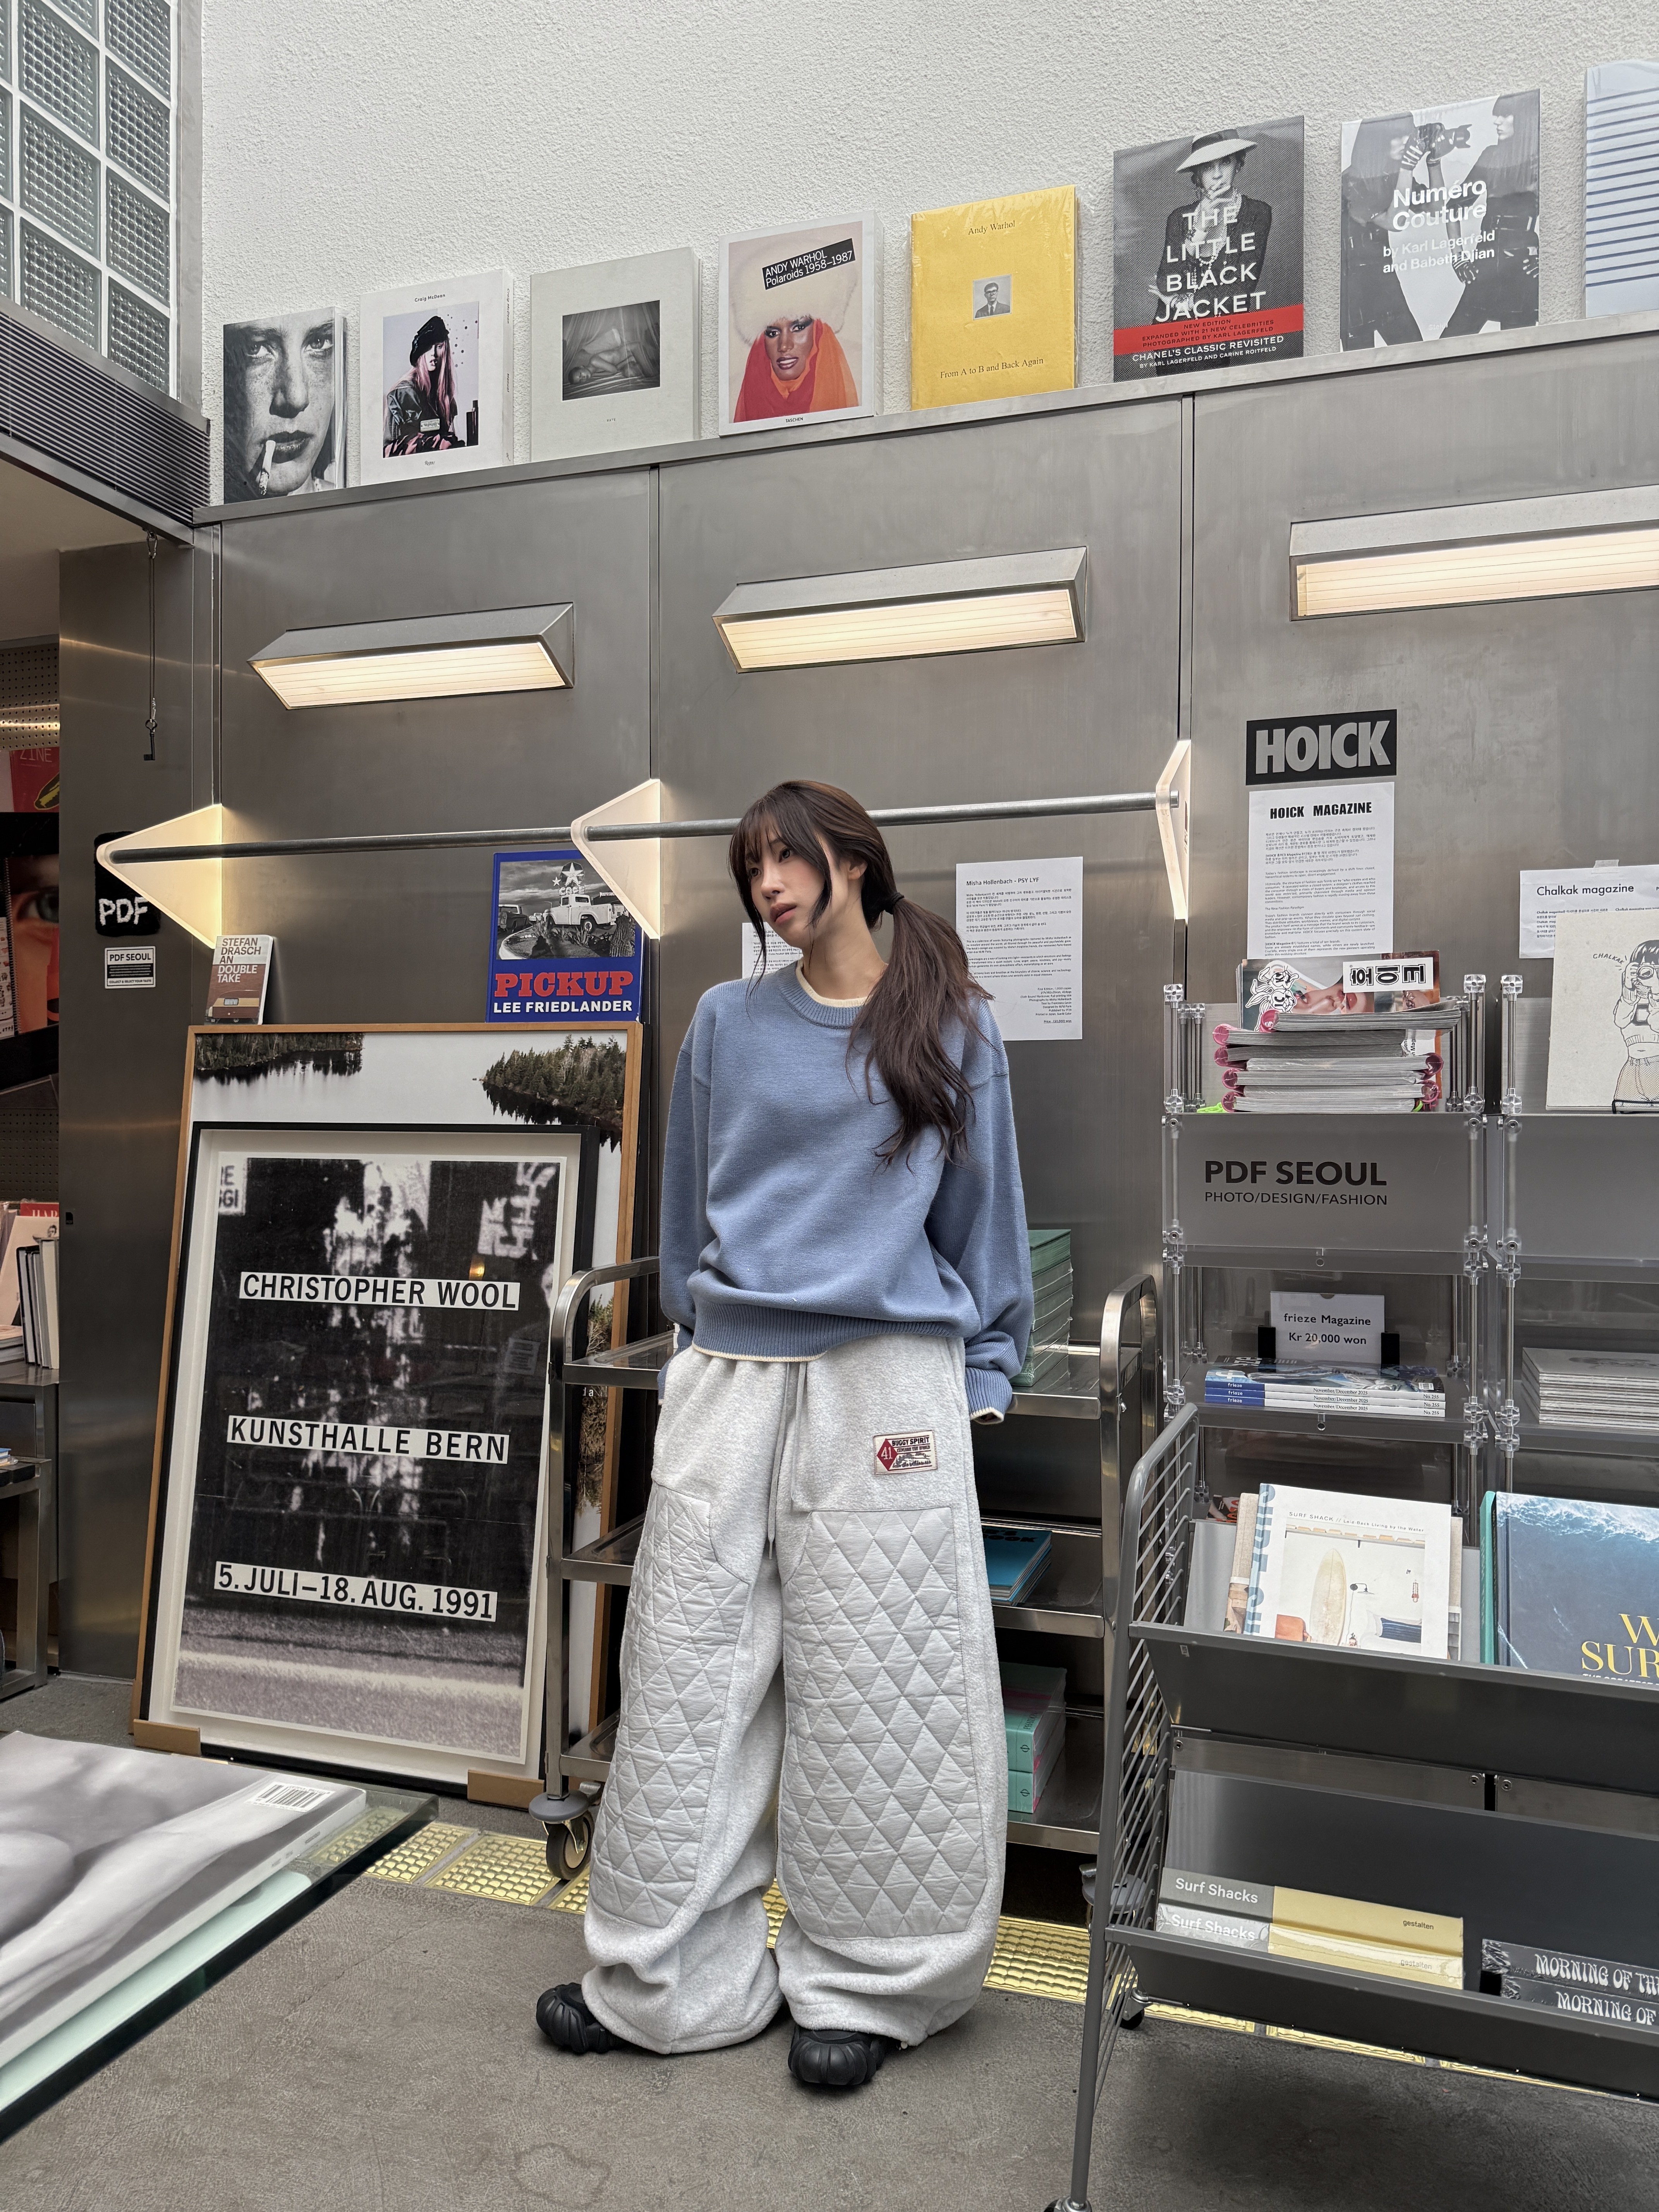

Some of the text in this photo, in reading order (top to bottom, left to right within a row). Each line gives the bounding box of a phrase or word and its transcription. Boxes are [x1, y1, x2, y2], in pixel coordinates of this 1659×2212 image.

[1394, 180, 1487, 208] Numéro
[968, 220, 1015, 235] Andy Warhol
[1182, 205, 1237, 230] THE
[1393, 204, 1487, 230] Couture
[1167, 232, 1255, 263] LITTLE
[1383, 230, 1495, 258] by Karl Lagerfeld
[765, 250, 828, 278] ANDY WARHOL
[1383, 259, 1407, 273] and
[1410, 254, 1458, 270] Babeth
[766, 268, 804, 287] Polaroids
[1167, 262, 1257, 292] BLACK
[1155, 291, 1266, 322] JACKET
[1142, 332, 1179, 341] EXPANDED
[1229, 319, 1274, 330] CELEBRITIES
[1142, 336, 1199, 347] PHOTOGRAPHED
[1233, 327, 1274, 336] LAGERFELD
[1132, 336, 1284, 362] CHANEL'S CLASSIC REVISITED
[1166, 356, 1203, 366] LAGERFELD
[1245, 347, 1277, 355] ROITFELD
[940, 370, 958, 379] From
[987, 363, 999, 372] and
[1001, 360, 1019, 369] Back
[1022, 357, 1044, 368] Again
[1256, 720, 1391, 774] HOICK
[1270, 802, 1372, 819] HOICK MAGAZINE
[559, 886, 585, 896] CAFE
[1536, 883, 1634, 896] Chalkak magazine
[98, 896, 149, 926] PDF
[221, 946, 261, 955] DRASCH
[222, 938, 258, 946] STEFAN
[126, 953, 151, 961] SEOUL
[220, 955, 234, 964] AN
[1593, 952, 1626, 965] CHALKAK
[217, 974, 241, 983] TAKE
[218, 965, 258, 974] DOUBLE
[494, 970, 634, 998] PICKUP
[493, 1000, 632, 1013] LEE FRIEDLANDER
[1205, 1161, 1387, 1186] PDF SEOUL
[1205, 1192, 1388, 1206] PHOTO/DESIGN/FASHION
[243, 1273, 516, 1309] CHRISTOPHER WOOL
[1284, 1313, 1371, 1327] frieze Magazine
[1289, 1332, 1302, 1341] Kr
[1305, 1333, 1340, 1344] 20,000
[231, 1418, 505, 1462] KUNSTHALLE BERN
[881, 1447, 893, 1460] 41
[1175, 1878, 1434, 1930] Surf Shacks gestalten
[1170, 1914, 1432, 1970] Surf Shacks gestalten
[1535, 1954, 1659, 1996] MORNING OF TH
[1556, 1992, 1656, 2026] MORNING OF
